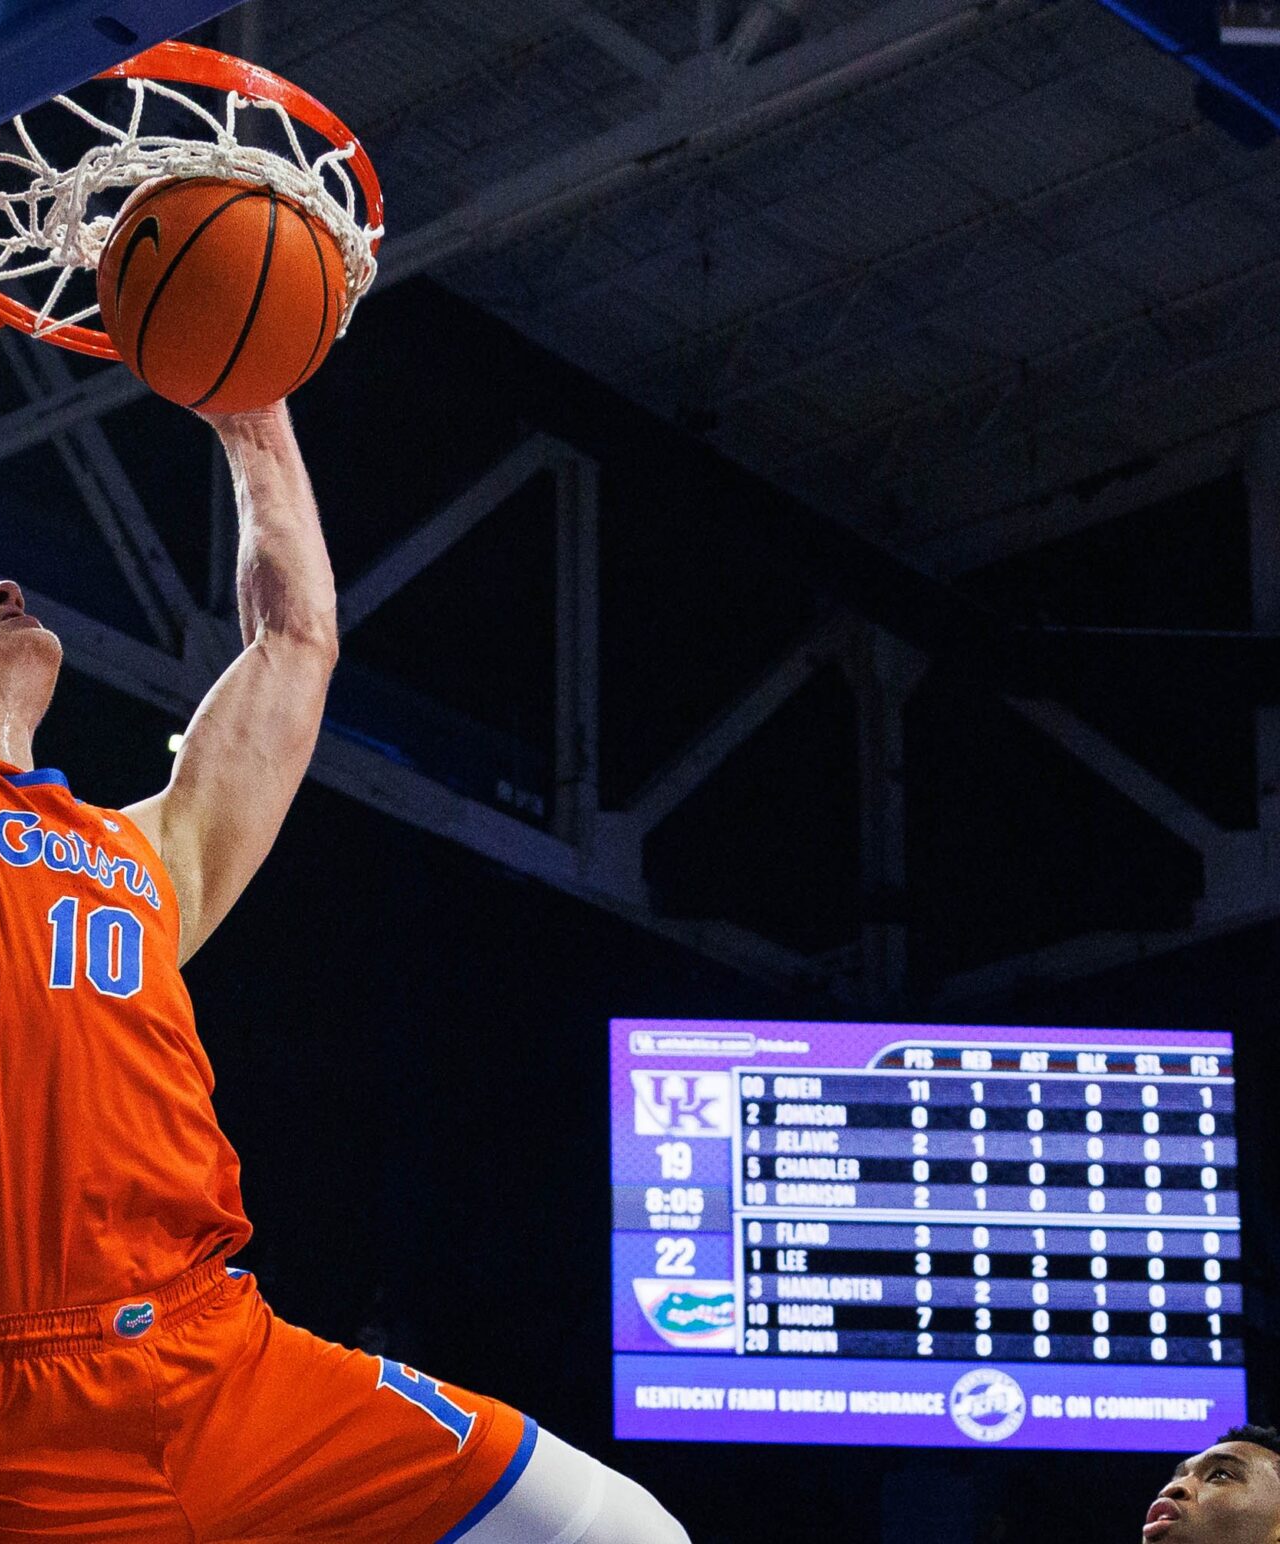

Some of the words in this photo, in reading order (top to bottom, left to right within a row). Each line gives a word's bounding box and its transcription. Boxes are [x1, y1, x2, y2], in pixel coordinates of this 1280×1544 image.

[48, 895, 144, 999] 10
[904, 1049, 933, 1070] PTS
[1020, 1052, 1049, 1072] AST
[1077, 1053, 1107, 1074] BLK
[1135, 1055, 1163, 1075] STL
[1191, 1056, 1219, 1077] FLS
[650, 1076, 711, 1129] UK
[909, 1080, 929, 1101] 11
[971, 1082, 983, 1102] 1
[1029, 1083, 1040, 1103] 1
[1086, 1084, 1101, 1105] 0
[1142, 1085, 1158, 1106] 0
[1200, 1087, 1212, 1108] 1
[746, 1103, 760, 1125] 2
[775, 1104, 846, 1126] JOHNSON
[912, 1107, 927, 1128] 0
[970, 1108, 985, 1129] 0
[1028, 1109, 1043, 1130] 0
[1087, 1111, 1102, 1132] 0
[1144, 1112, 1159, 1133] 0
[1199, 1114, 1215, 1135] 0
[655, 1141, 693, 1181] 19
[746, 1130, 761, 1152] 4
[775, 1131, 839, 1154] JELAVIC
[913, 1133, 928, 1155] 2
[972, 1135, 985, 1156] 1
[1030, 1136, 1042, 1158] 1
[1087, 1137, 1103, 1159] 0
[1144, 1139, 1160, 1161] 0
[1201, 1140, 1214, 1162] 1
[747, 1157, 761, 1178] 5
[775, 1158, 860, 1180] CHANDLER
[914, 1161, 928, 1181] 0
[972, 1162, 987, 1183] 0
[1029, 1163, 1045, 1184] 0
[1088, 1165, 1103, 1185] 0
[1146, 1166, 1161, 1187] 0
[1201, 1167, 1217, 1188] 0
[645, 1187, 705, 1215] 8:05
[746, 1183, 767, 1205] 10
[914, 1186, 929, 1208] 2
[974, 1188, 986, 1209] 1
[1029, 1189, 1046, 1211] 0
[1089, 1191, 1105, 1212] 0
[1146, 1192, 1162, 1214] 0
[1204, 1194, 1216, 1215] 1
[655, 1236, 696, 1276] 22
[915, 1226, 930, 1247] 3
[973, 1227, 989, 1249] 0
[1033, 1229, 1045, 1249] 1
[1090, 1230, 1106, 1251] 0
[1147, 1231, 1163, 1252] 0
[1203, 1232, 1219, 1254] 0
[751, 1250, 761, 1270] 1
[777, 1250, 808, 1272] LEE
[916, 1253, 930, 1274] 3
[974, 1254, 989, 1275] 0
[1033, 1256, 1047, 1277] 2
[1092, 1257, 1106, 1278] 0
[1149, 1258, 1164, 1279] 0
[1205, 1260, 1220, 1280] 0
[748, 1276, 763, 1298] 3
[916, 1280, 932, 1301] 0
[975, 1281, 990, 1303] 2
[1033, 1283, 1048, 1304] 0
[1094, 1284, 1106, 1305] 1
[1149, 1285, 1165, 1307] 0
[1205, 1286, 1221, 1308] 0
[747, 1304, 768, 1325] 10
[778, 1305, 834, 1326] HAUGH
[917, 1307, 931, 1328] 7
[976, 1309, 990, 1329] 3
[1034, 1310, 1049, 1331] 0
[1093, 1311, 1108, 1332] 0
[1151, 1312, 1166, 1333] 0
[1209, 1314, 1220, 1334] 1
[745, 1329, 769, 1351] 20
[918, 1333, 932, 1354] 2
[976, 1334, 991, 1356] 0
[1034, 1336, 1050, 1357] 0
[1094, 1337, 1109, 1358] 0
[1151, 1338, 1167, 1359] 0
[1210, 1340, 1221, 1360] 1
[635, 1386, 725, 1409] KENTUCKY
[727, 1388, 776, 1411] FARM
[778, 1389, 847, 1413] BUREAU
[848, 1391, 946, 1416] INSURANCE
[1031, 1395, 1063, 1418] BIG
[1065, 1396, 1092, 1418] ON
